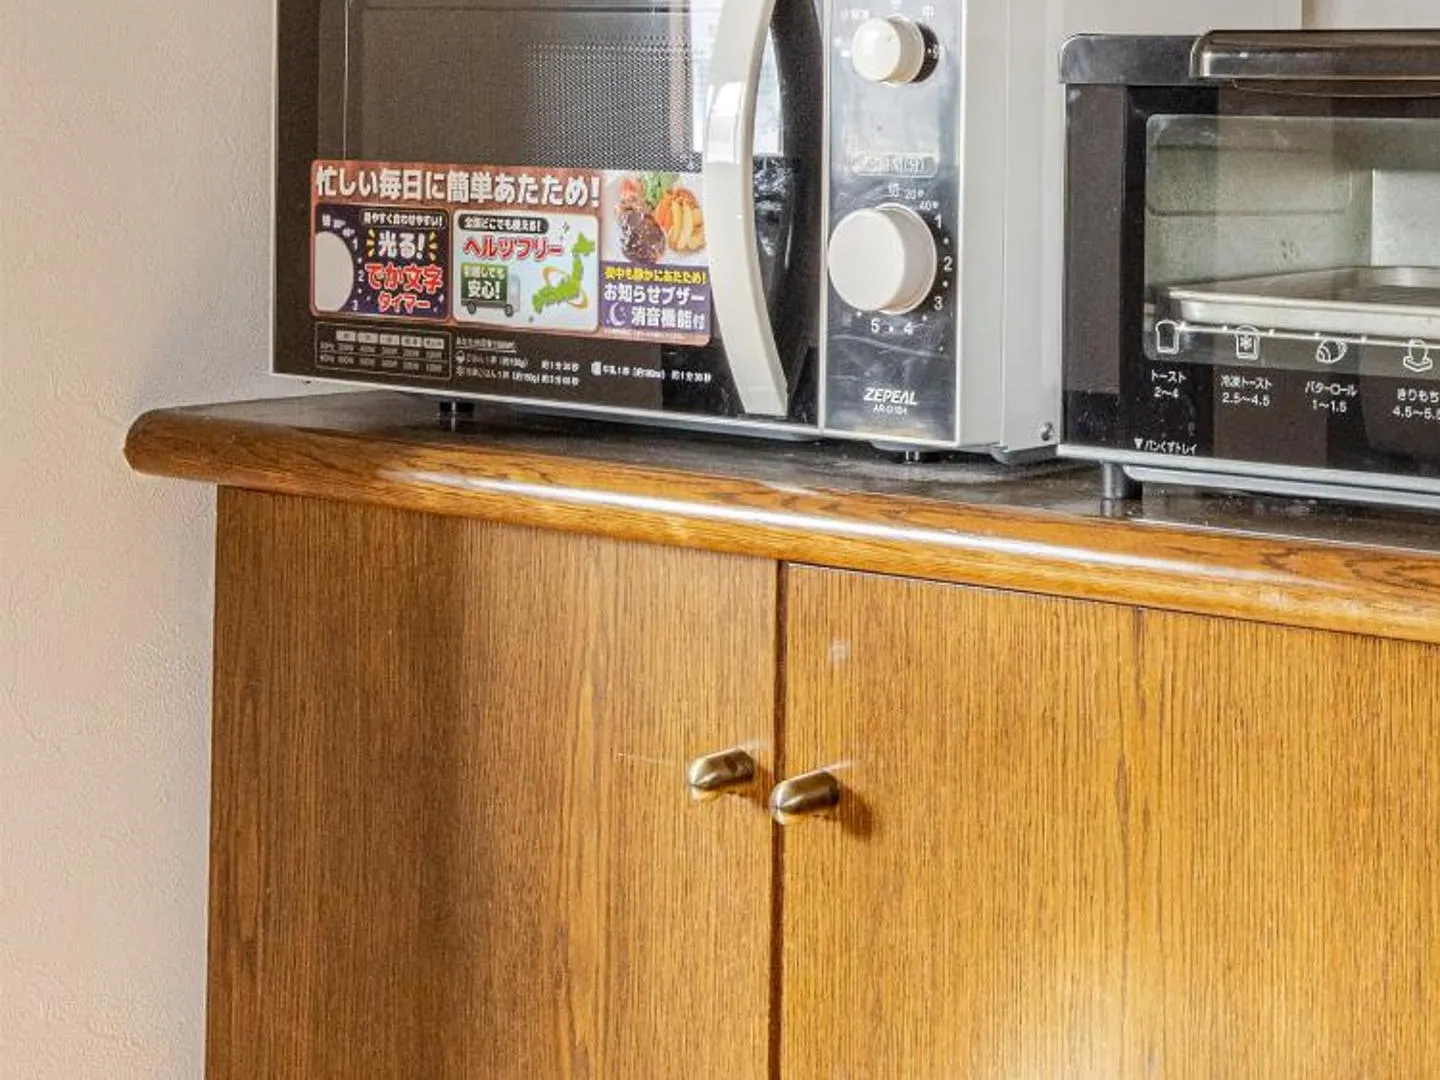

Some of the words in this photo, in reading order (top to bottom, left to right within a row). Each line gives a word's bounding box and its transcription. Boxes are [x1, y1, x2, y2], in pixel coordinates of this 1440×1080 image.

[934, 214, 942, 229] 1
[377, 230, 426, 259] 光る!
[463, 234, 564, 262] ヘルツフリー
[943, 256, 953, 271] 2
[365, 262, 444, 294] でか文字
[377, 291, 432, 313] タイマー
[604, 283, 706, 305] お知らせブザー
[933, 296, 943, 311] 3
[870, 318, 881, 334] 5
[903, 321, 914, 335] 4
[1151, 370, 1186, 384] トースト
[1220, 374, 1272, 390] 冷凍トースト
[863, 387, 919, 406] ZEPEAL
